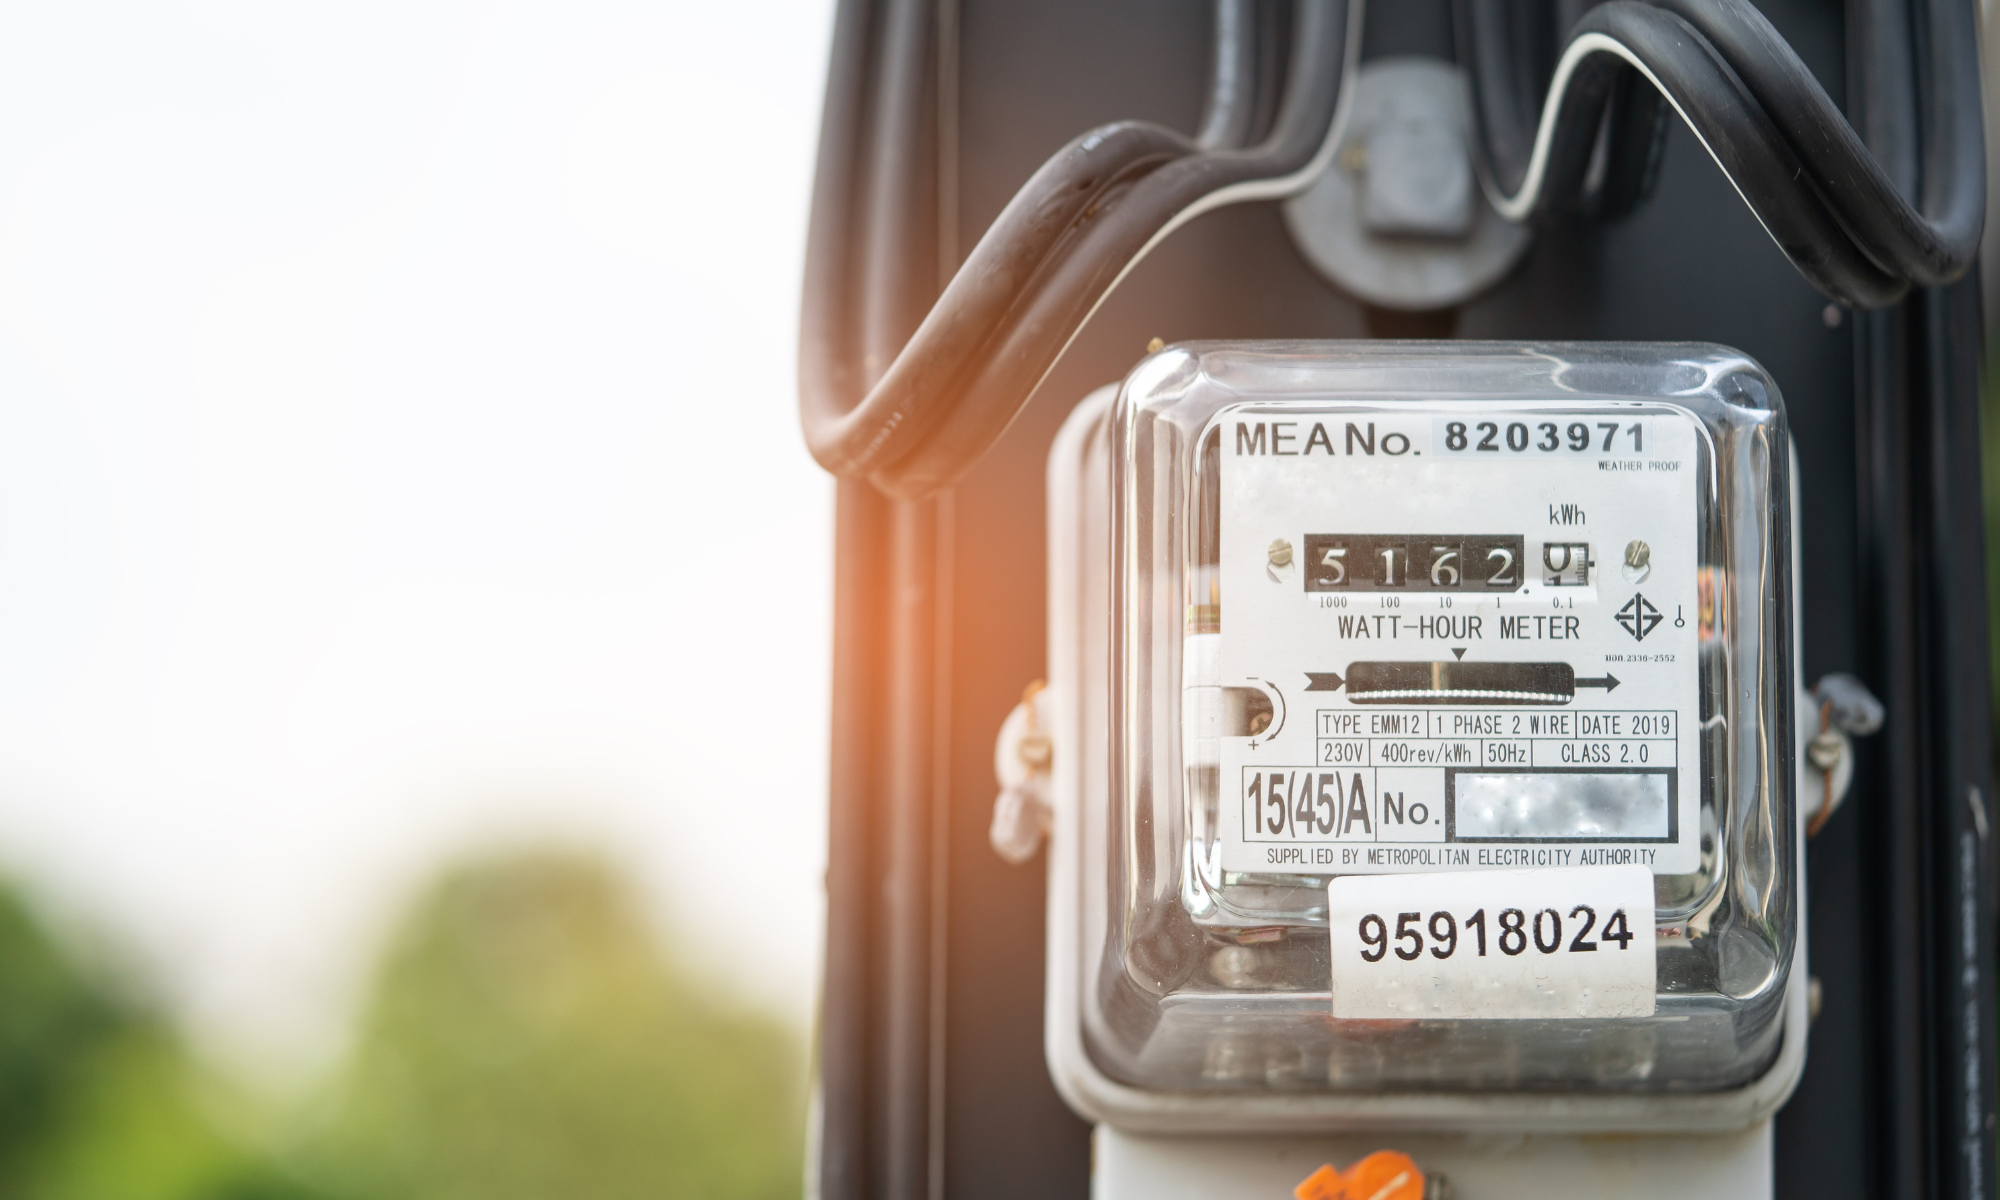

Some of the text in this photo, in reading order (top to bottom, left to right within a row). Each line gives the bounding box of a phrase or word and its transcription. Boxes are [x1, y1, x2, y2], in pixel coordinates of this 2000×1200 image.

[1346, 423, 1421, 455] No.
[1446, 422, 1643, 451] 8203971
[1598, 460, 1682, 471] WEATHER PROOF
[1549, 503, 1586, 526] kWh
[1320, 596, 1348, 609] 1000
[1380, 596, 1400, 609] 100
[1439, 596, 1453, 609] 10
[1552, 596, 1573, 609] 0.1
[1338, 615, 1580, 640] WATT-HOUR METER
[1322, 714, 1420, 734] TYPE EMM12
[1454, 714, 1503, 735] PHASE
[1512, 715, 1521, 735] 2
[1529, 715, 1570, 735] WIRE
[1582, 715, 1670, 735] DATE 2019
[1324, 742, 1364, 763] 230V
[1381, 742, 1471, 764] 400rev/kWh
[1488, 743, 1526, 763] 50Hz
[1561, 743, 1649, 763] CLASS 2.0
[1249, 771, 1372, 837] 15(45)A
[1384, 792, 1440, 824] No.
[1267, 848, 1656, 866] SUPPLIED BY METROPOLITAN ELECTRICITY AUTHORITY
[1359, 905, 1634, 962] 95918024
